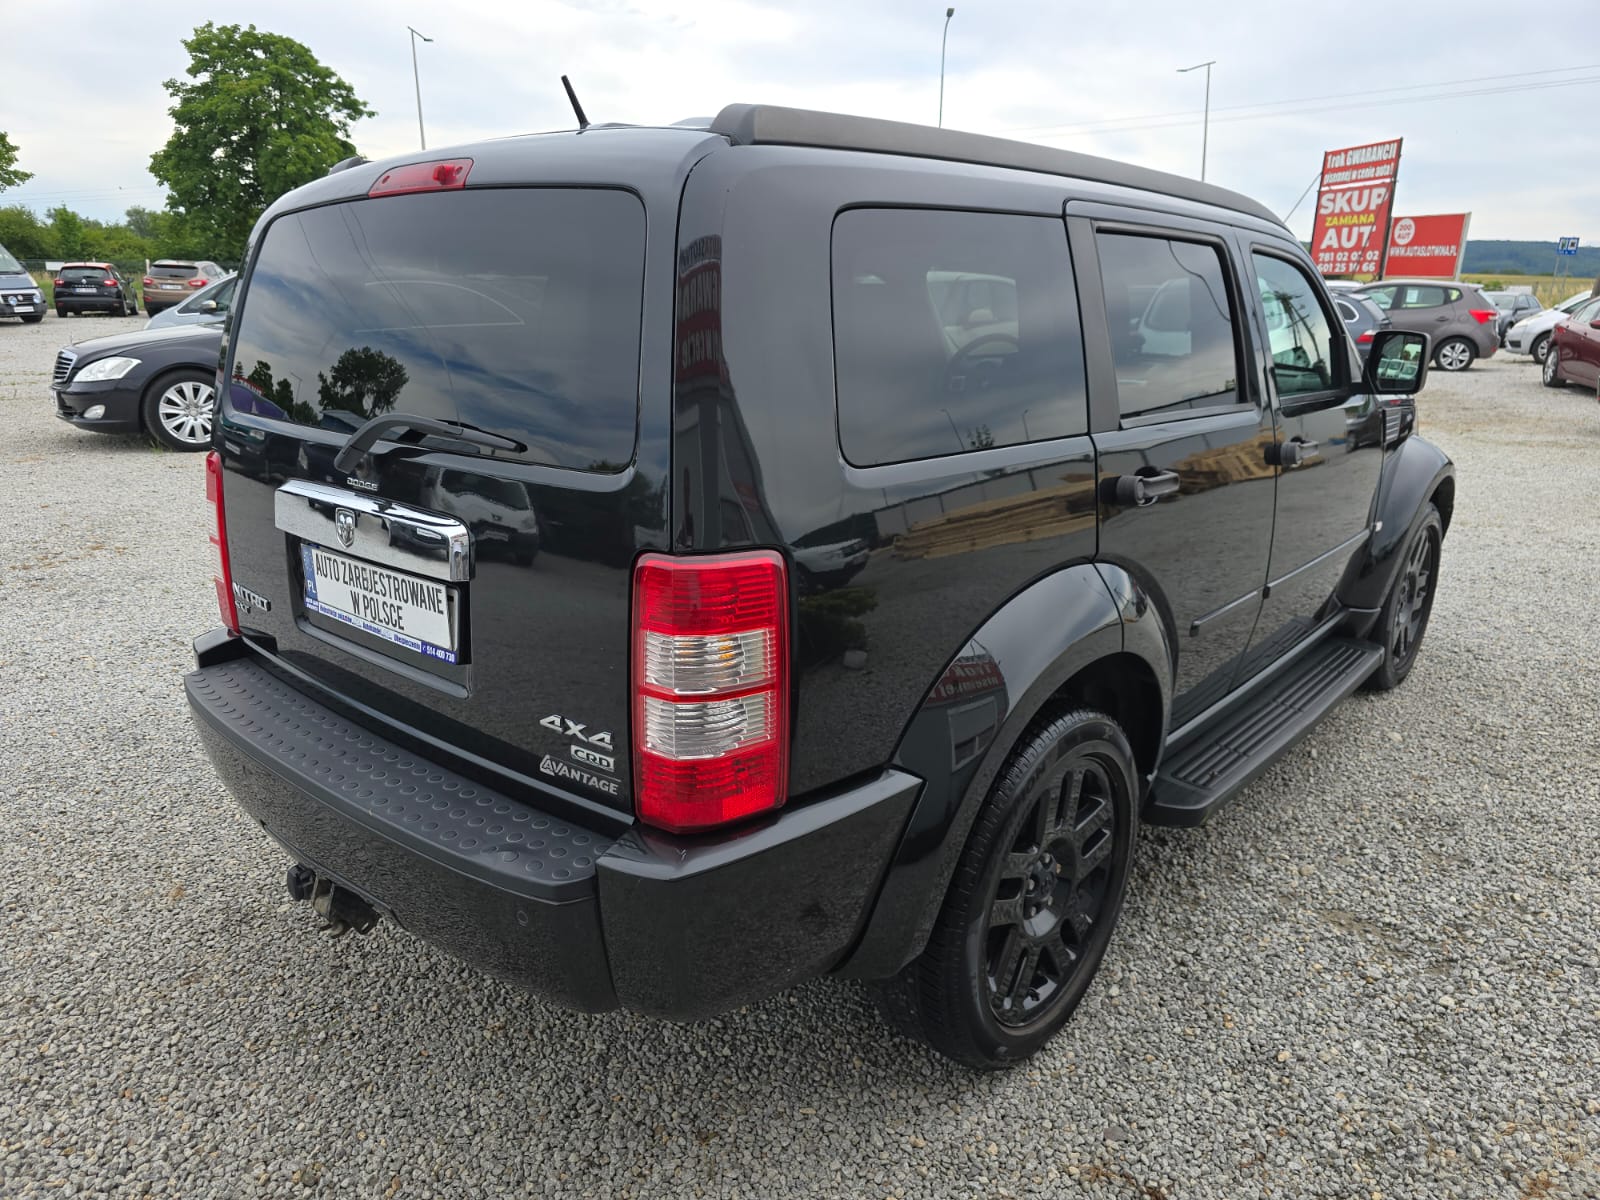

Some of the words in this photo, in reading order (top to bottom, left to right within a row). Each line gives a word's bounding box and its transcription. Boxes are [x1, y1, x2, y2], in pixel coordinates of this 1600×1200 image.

[1319, 187, 1389, 215] SKUP
[1325, 213, 1375, 227] ZAMIANA
[1320, 225, 1376, 249] AUT
[1366, 250, 1380, 260] 02
[346, 477, 378, 491] DODGE
[315, 553, 340, 582] AUTO
[306, 579, 317, 593] PL
[350, 590, 360, 615] W
[362, 594, 405, 630] POLSCE
[573, 748, 612, 769] CRD
[539, 754, 619, 795] AVANTAGE
